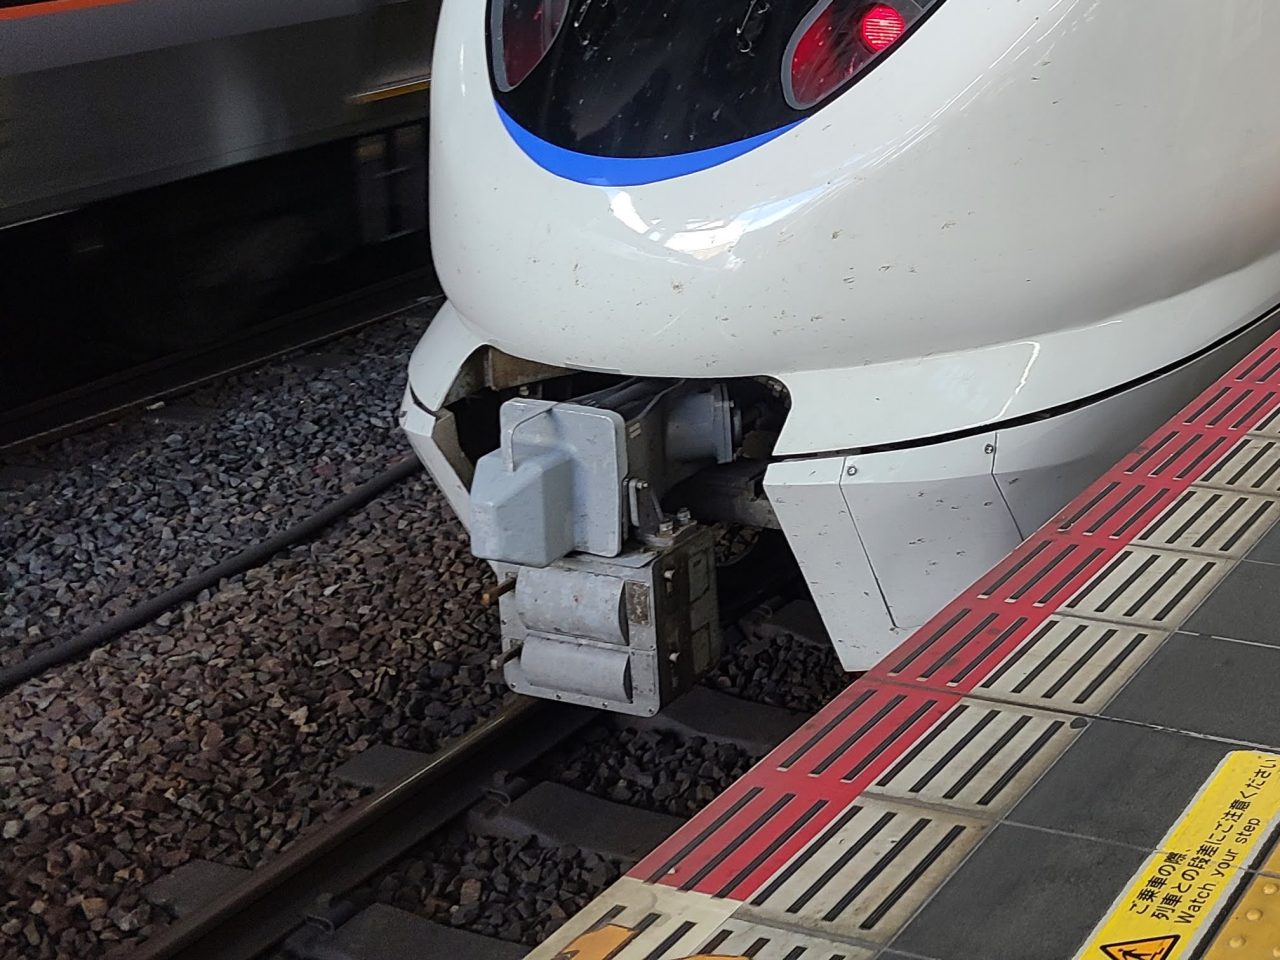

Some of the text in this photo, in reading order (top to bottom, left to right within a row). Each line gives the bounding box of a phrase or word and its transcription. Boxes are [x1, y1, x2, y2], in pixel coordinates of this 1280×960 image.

[1151, 758, 1277, 921] 列車との段差にご注意ください
[1174, 816, 1261, 924] Watch your step
